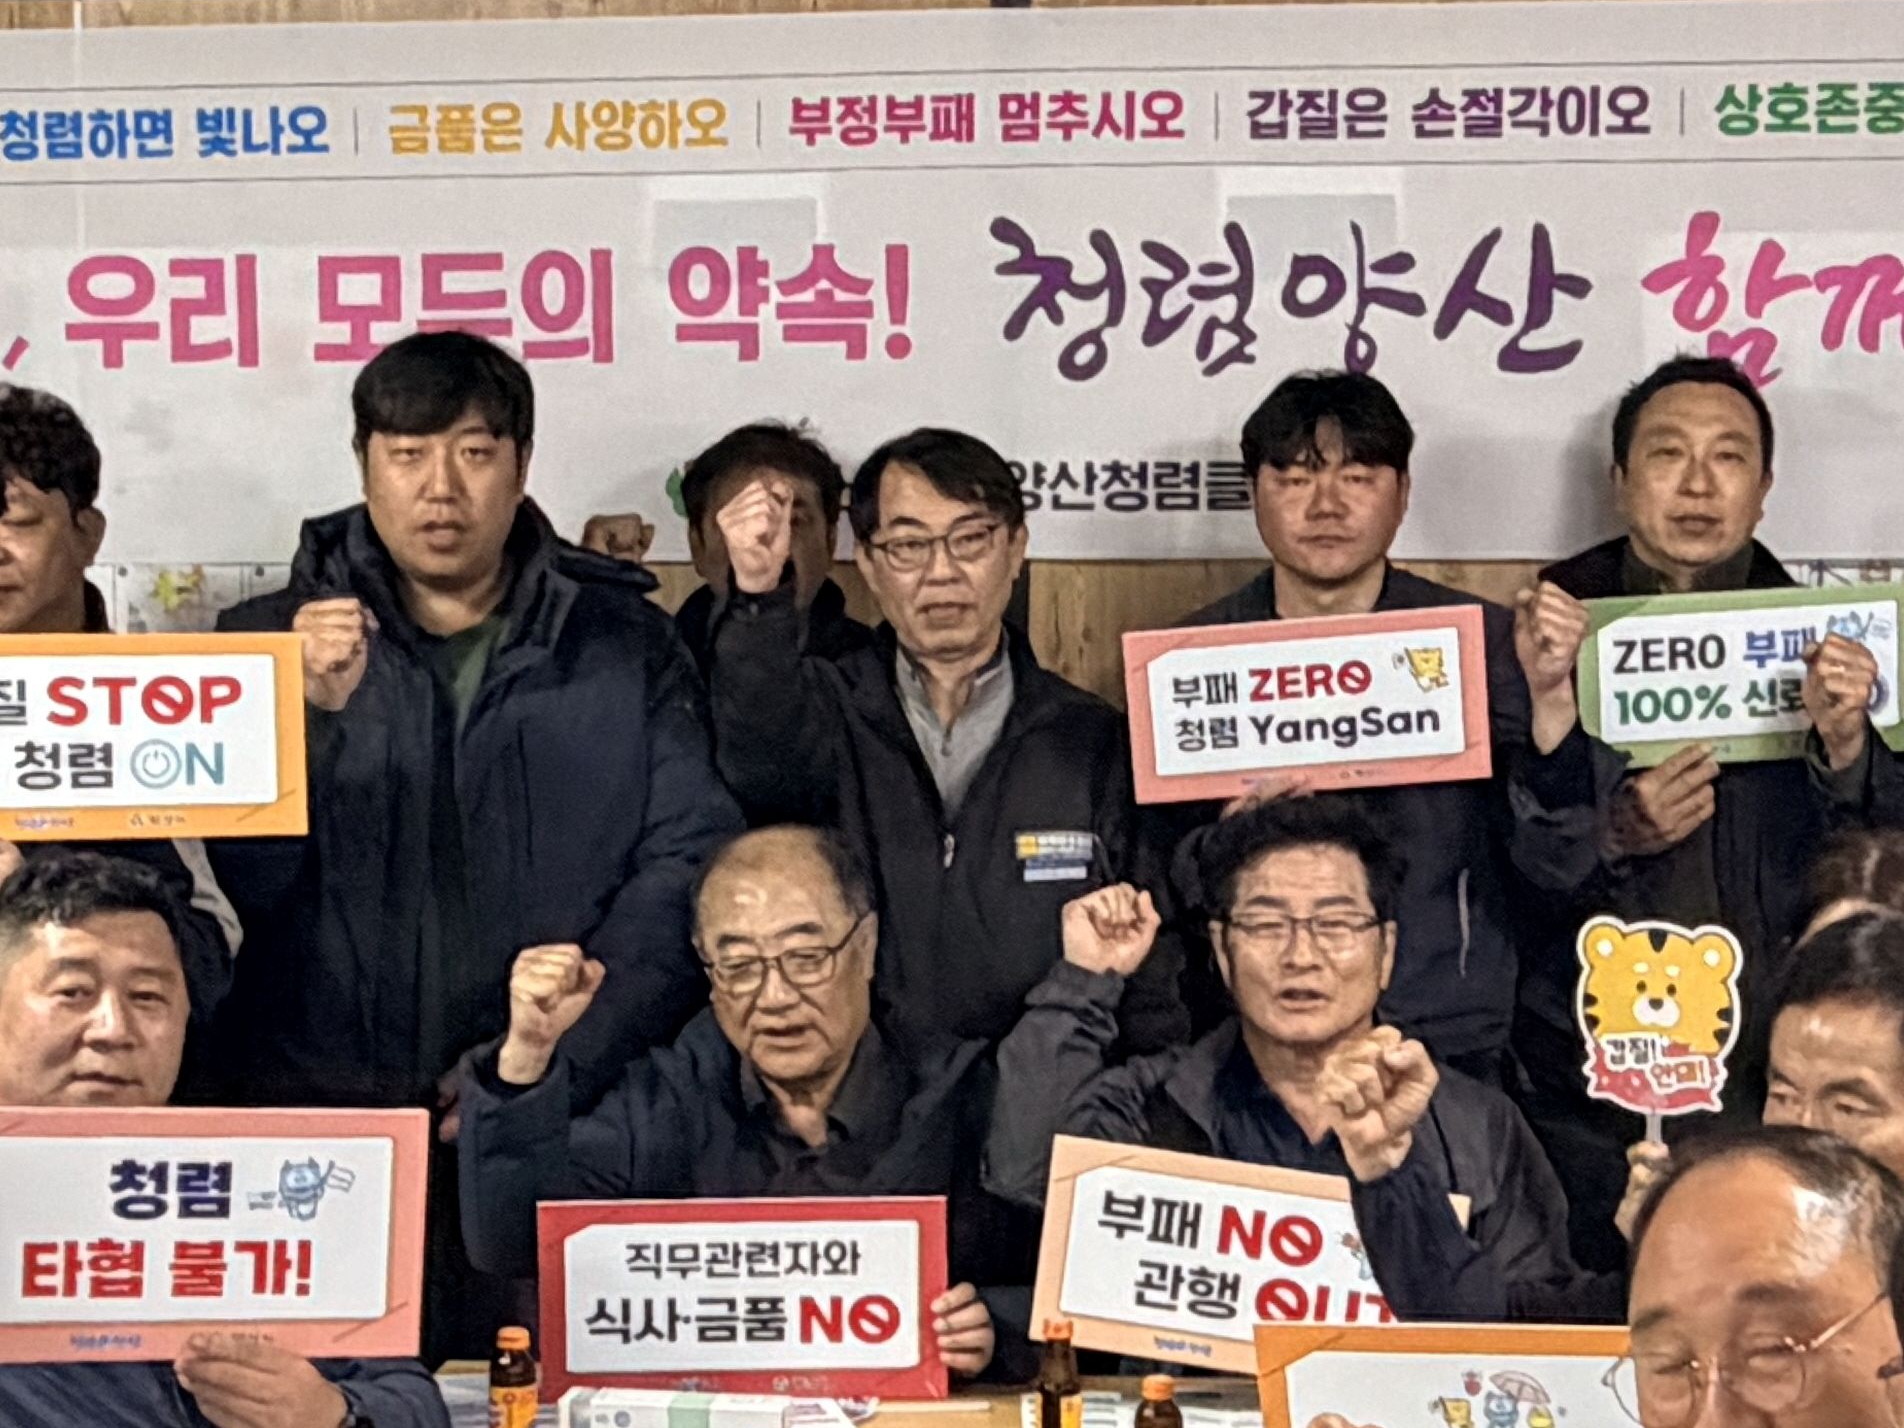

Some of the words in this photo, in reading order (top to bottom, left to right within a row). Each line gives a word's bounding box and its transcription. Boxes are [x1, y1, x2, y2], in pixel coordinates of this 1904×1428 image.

[196, 107, 331, 159] 빛나오
[388, 103, 524, 154] 금품은
[545, 99, 729, 152] 사양하오
[789, 92, 977, 146] 부정부패
[998, 90, 1186, 144] 멈추시오
[1246, 87, 1389, 140] 갑질은
[1411, 85, 1652, 139] 손절각이오
[65, 254, 259, 369] 우리
[314, 248, 613, 363] 모두의
[668, 243, 912, 361] 약속!
[990, 216, 1593, 381] 청렴양산
[1613, 634, 1726, 674] ZERO
[47, 675, 242, 726] STOP
[1172, 672, 1238, 708] 부패
[1249, 660, 1373, 703] ZERO
[1615, 683, 1732, 725] 100%
[1175, 715, 1239, 751] 청렴
[1249, 706, 1440, 748] YangSan
[15, 740, 114, 790] 청렴
[130, 737, 225, 789] ON
[110, 1159, 234, 1220] 청렴
[1098, 1189, 1202, 1250] 부패
[1218, 1204, 1324, 1266] NO
[22, 1238, 145, 1299] 타협
[169, 1238, 312, 1298] 불가!
[625, 1239, 862, 1280] 직무관련자와
[1134, 1258, 1241, 1320] 관행
[800, 1294, 901, 1343] NO
